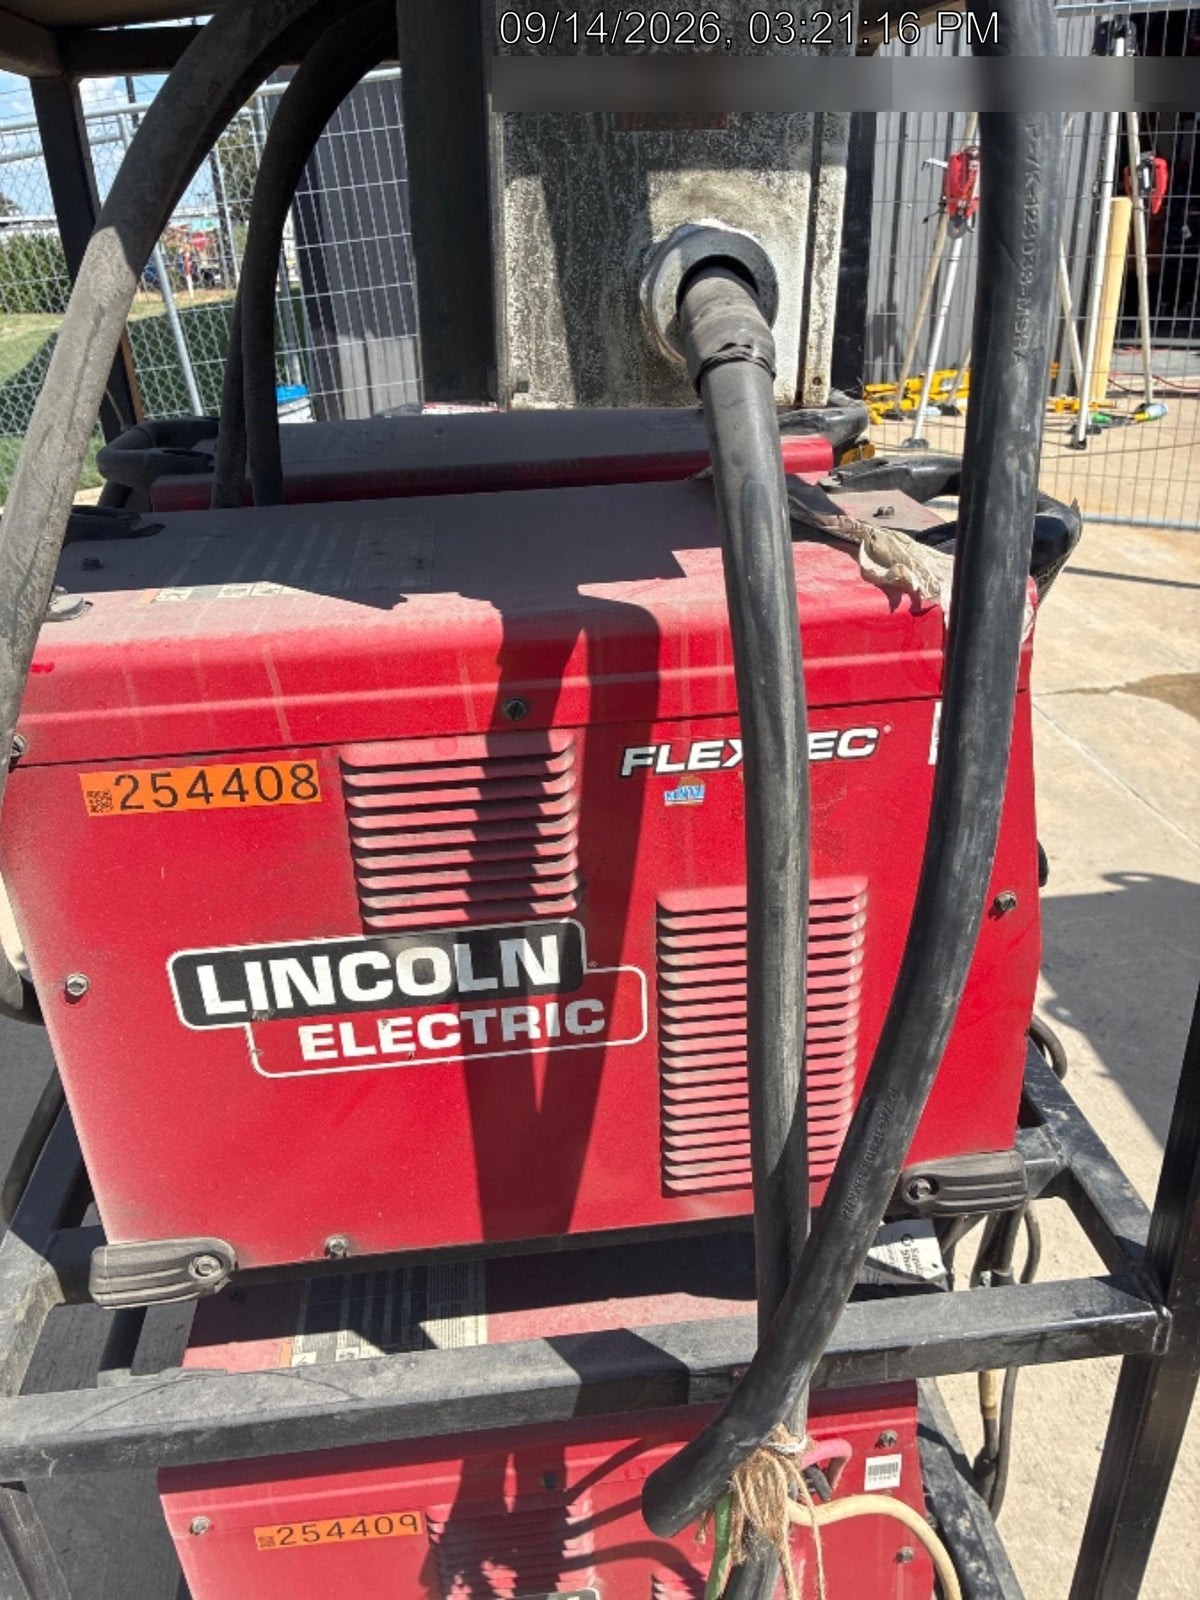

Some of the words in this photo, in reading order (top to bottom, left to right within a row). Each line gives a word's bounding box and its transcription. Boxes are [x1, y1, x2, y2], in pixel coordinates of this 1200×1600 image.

[620, 727, 880, 777] FLEXEC
[113, 763, 320, 812] 254408
[196, 934, 561, 1017] LINCOLN
[298, 997, 607, 1063] ELECTRIC
[275, 1513, 419, 1547] 254409
